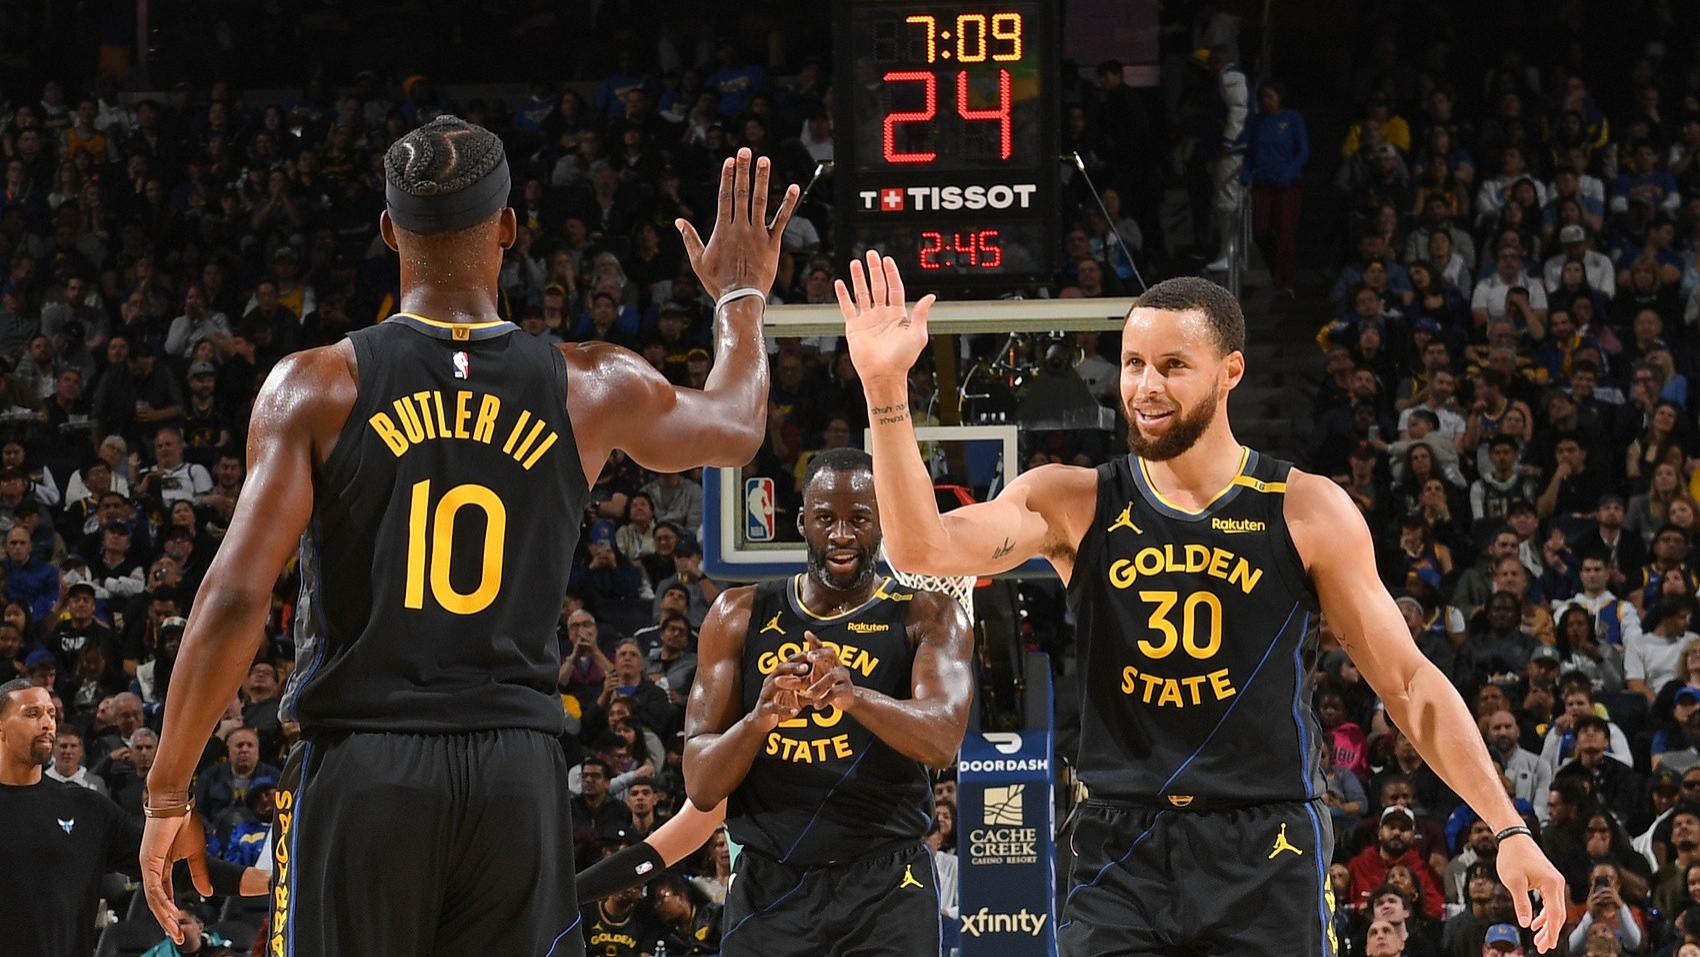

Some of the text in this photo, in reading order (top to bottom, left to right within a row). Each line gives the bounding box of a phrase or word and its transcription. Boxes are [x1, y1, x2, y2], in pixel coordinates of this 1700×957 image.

[906, 13, 1021, 63] 7:09
[883, 69, 1011, 164] 24
[907, 184, 1037, 211] TISSOT
[920, 230, 1002, 269] 2:45
[368, 390, 559, 471] BUTLER III
[1212, 518, 1266, 532] Rakuten
[404, 478, 507, 615] 10
[1109, 544, 1263, 594] GOLDEN
[847, 622, 889, 632] Rakuten
[1137, 591, 1222, 659] 30
[1121, 666, 1236, 708] STATE
[766, 732, 853, 763] STATE
[960, 759, 1048, 772] DOORDASH
[969, 828, 1037, 842] CACHE
[969, 842, 1038, 856] CREEK
[271, 790, 293, 957] ARRIORS
[971, 856, 1038, 865] CASINO RESORT
[960, 907, 1047, 937] xfinity
[591, 933, 637, 948] GOLDEN
